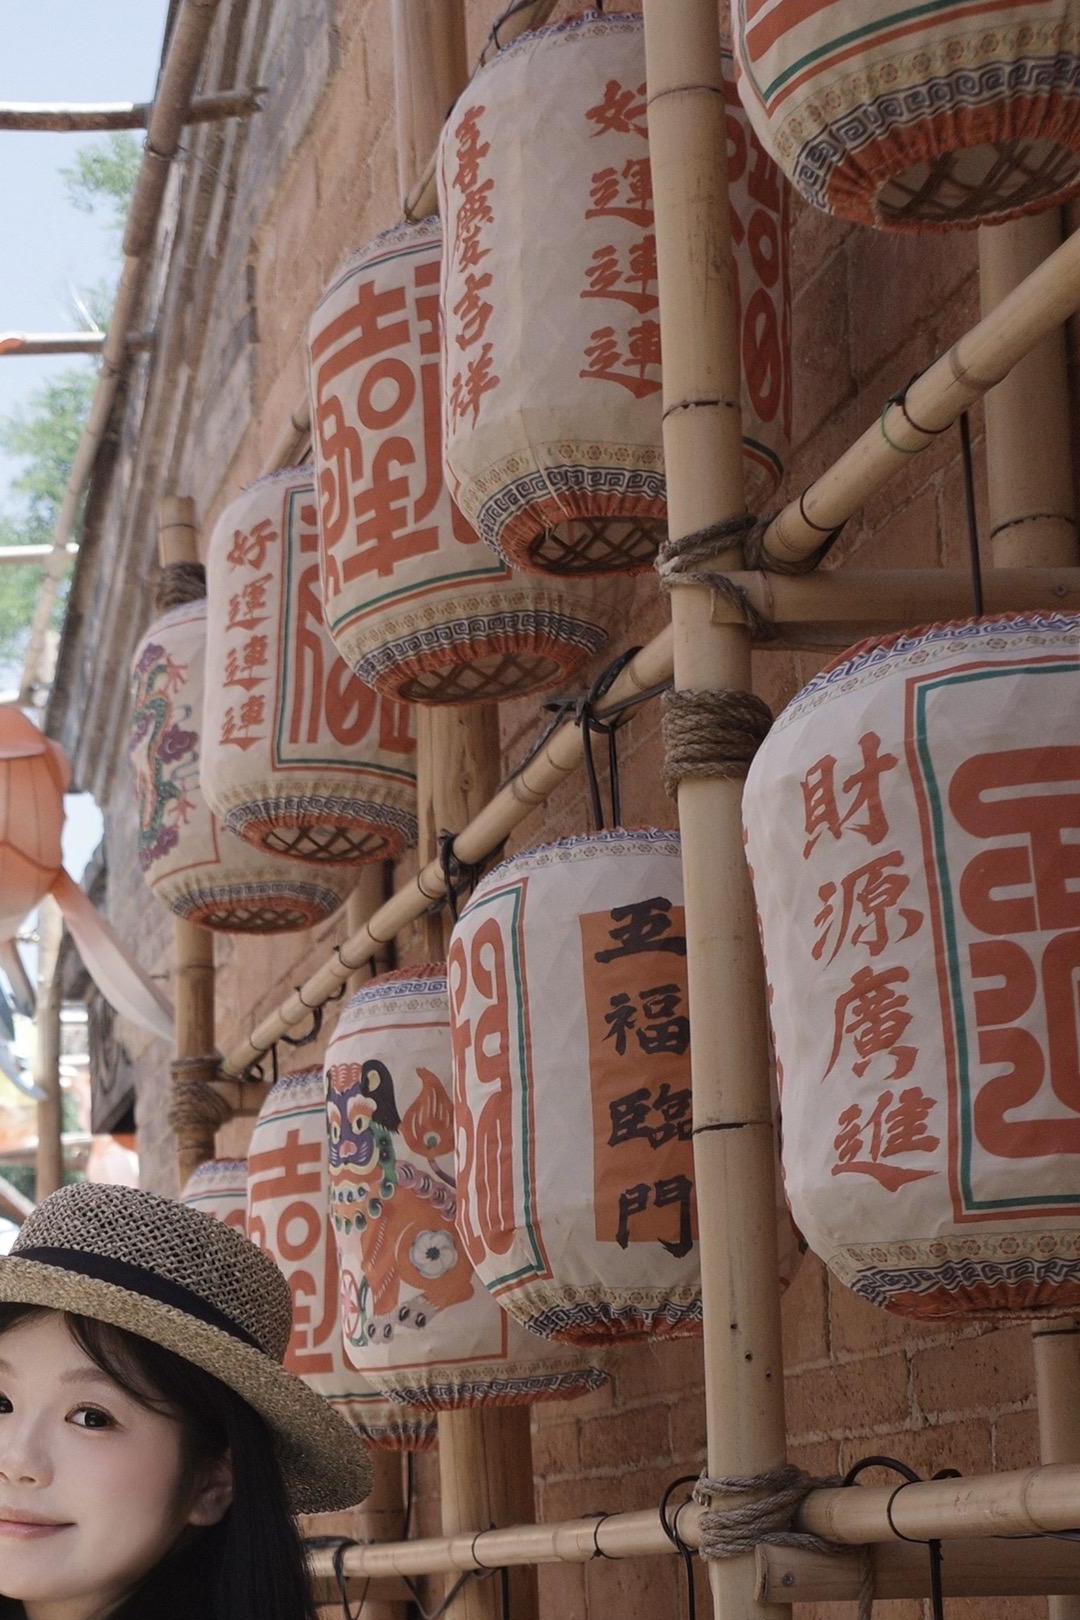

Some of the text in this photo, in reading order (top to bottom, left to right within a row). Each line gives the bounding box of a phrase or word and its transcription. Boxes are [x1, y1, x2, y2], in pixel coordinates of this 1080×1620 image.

[218, 518, 278, 752] 好運連連
[595, 896, 695, 1259] 五福臨門
[799, 730, 941, 1193] 財源廣進
